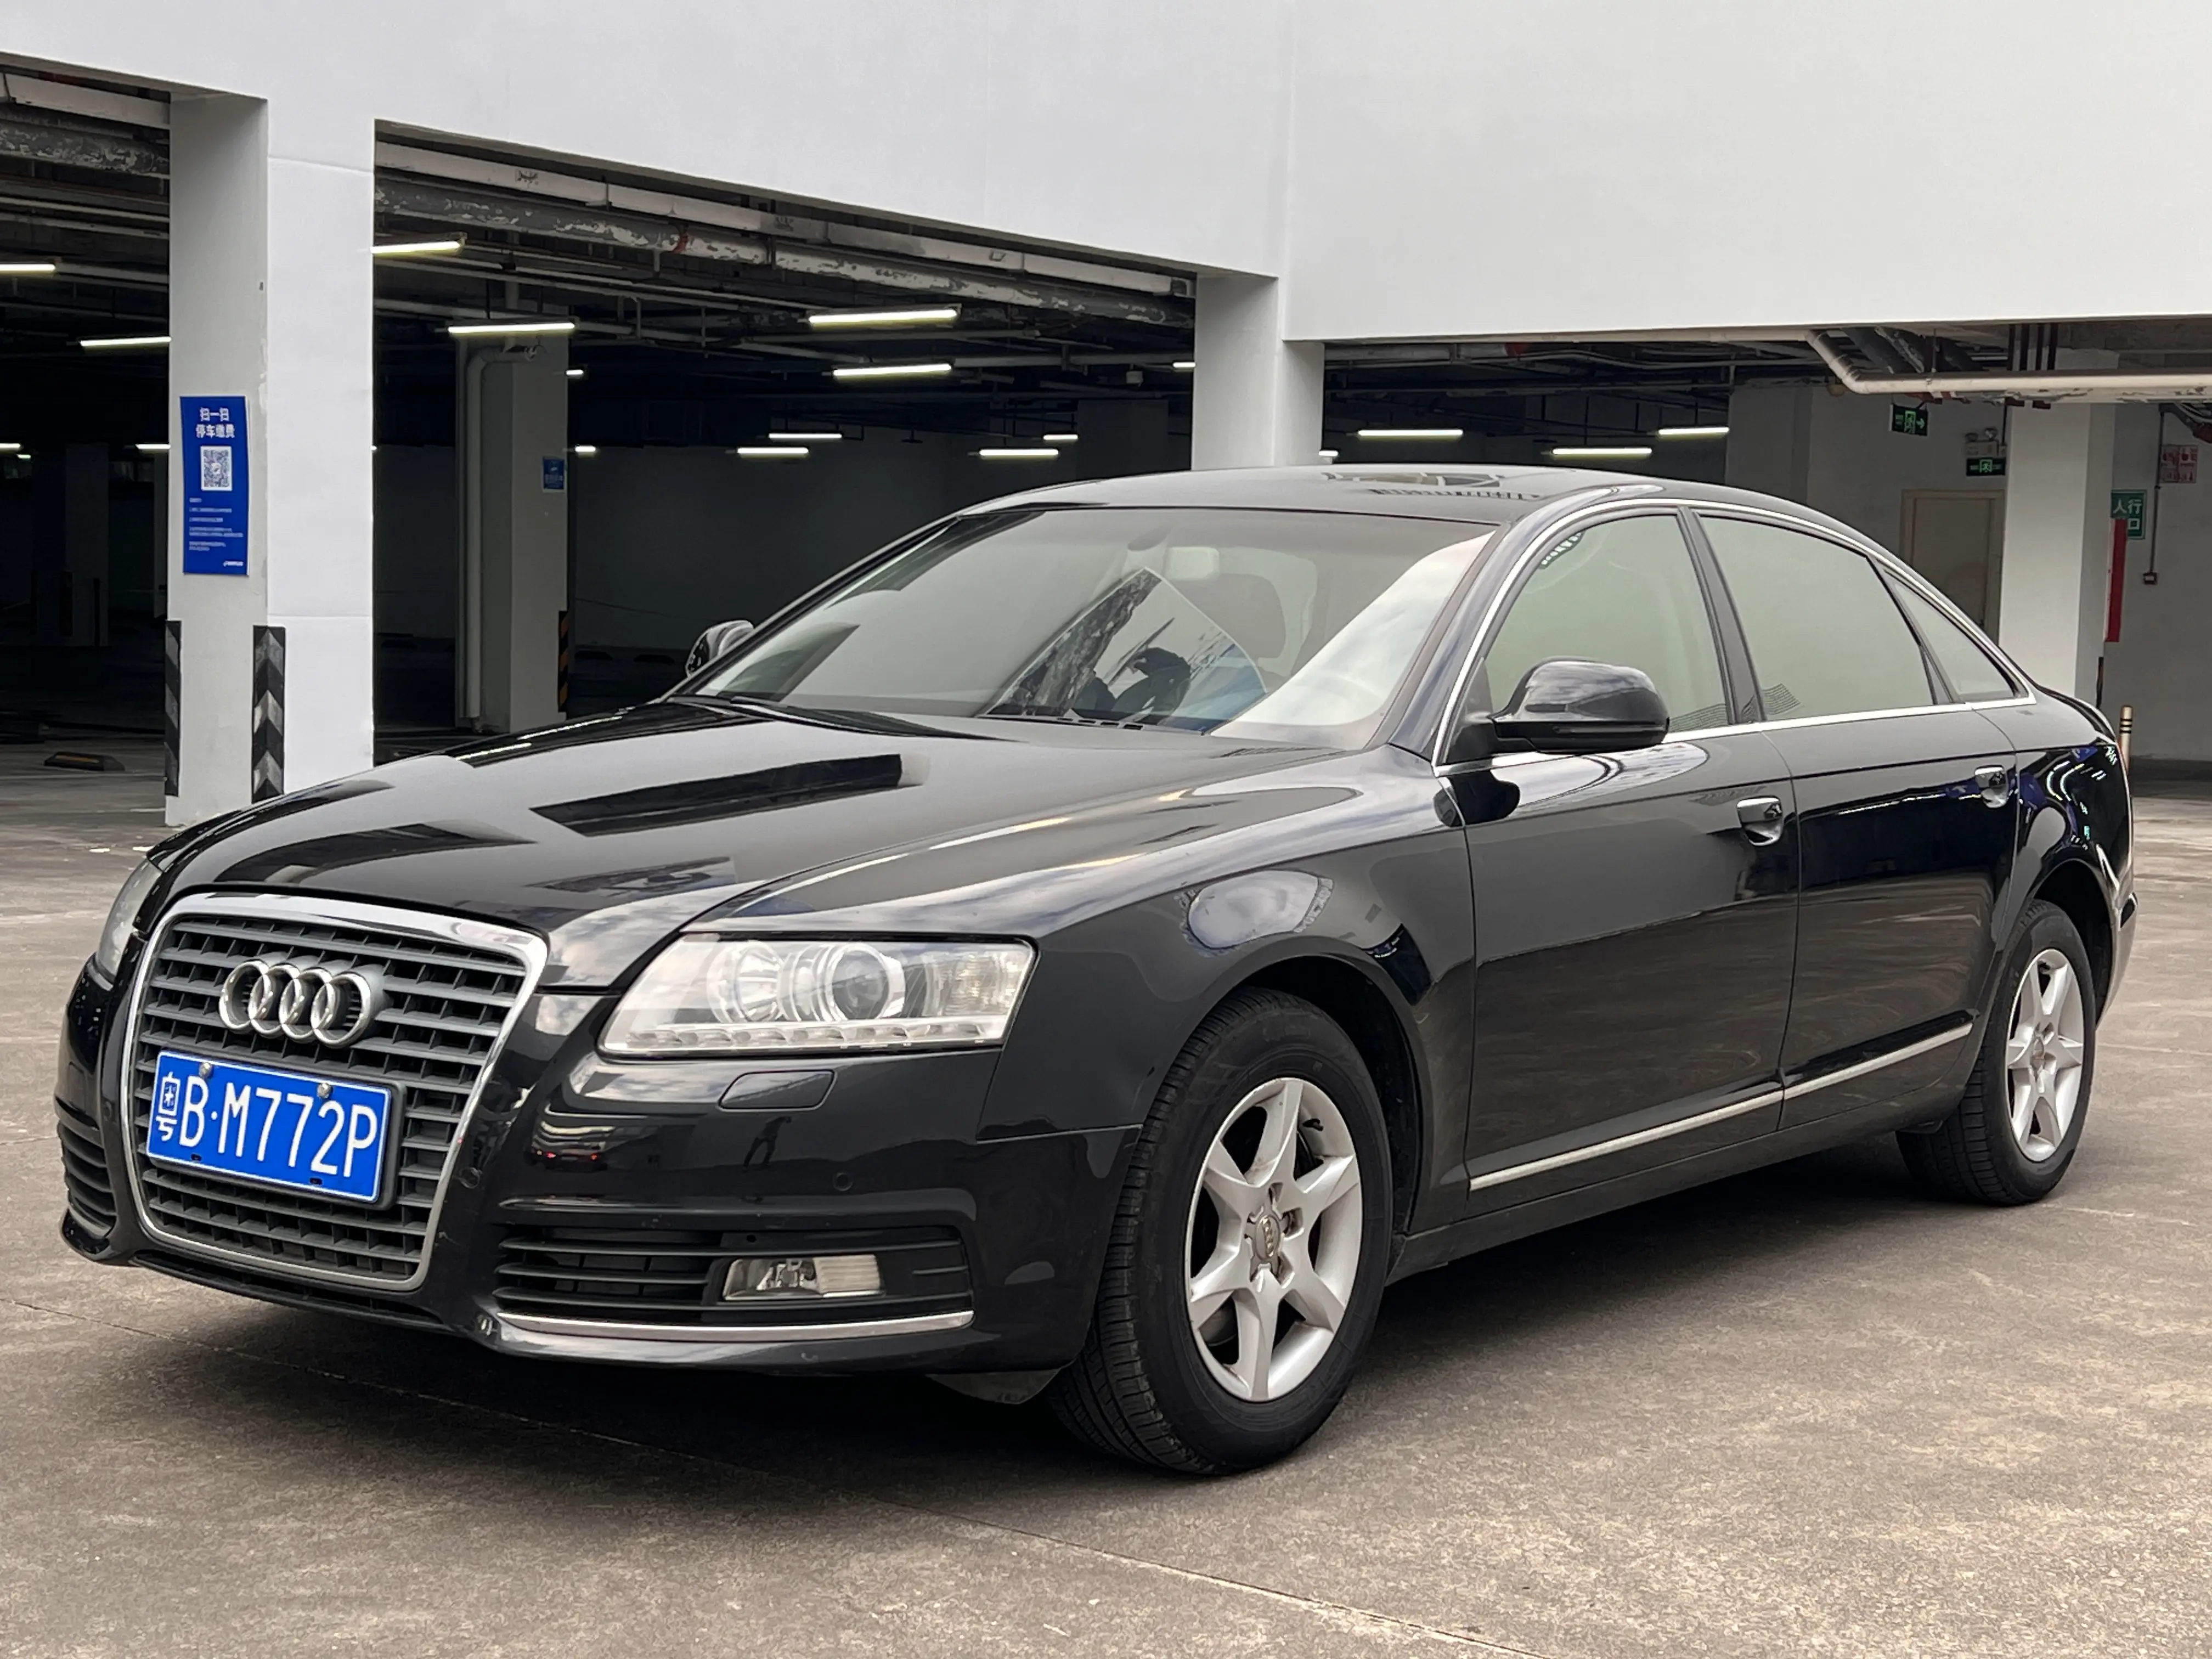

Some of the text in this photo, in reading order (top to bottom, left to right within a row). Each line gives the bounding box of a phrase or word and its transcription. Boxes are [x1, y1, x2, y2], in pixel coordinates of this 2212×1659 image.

[2113, 498, 2142, 515] 人行
[2128, 518, 2140, 530] 口
[156, 1071, 377, 1178] 粤B·M772P
